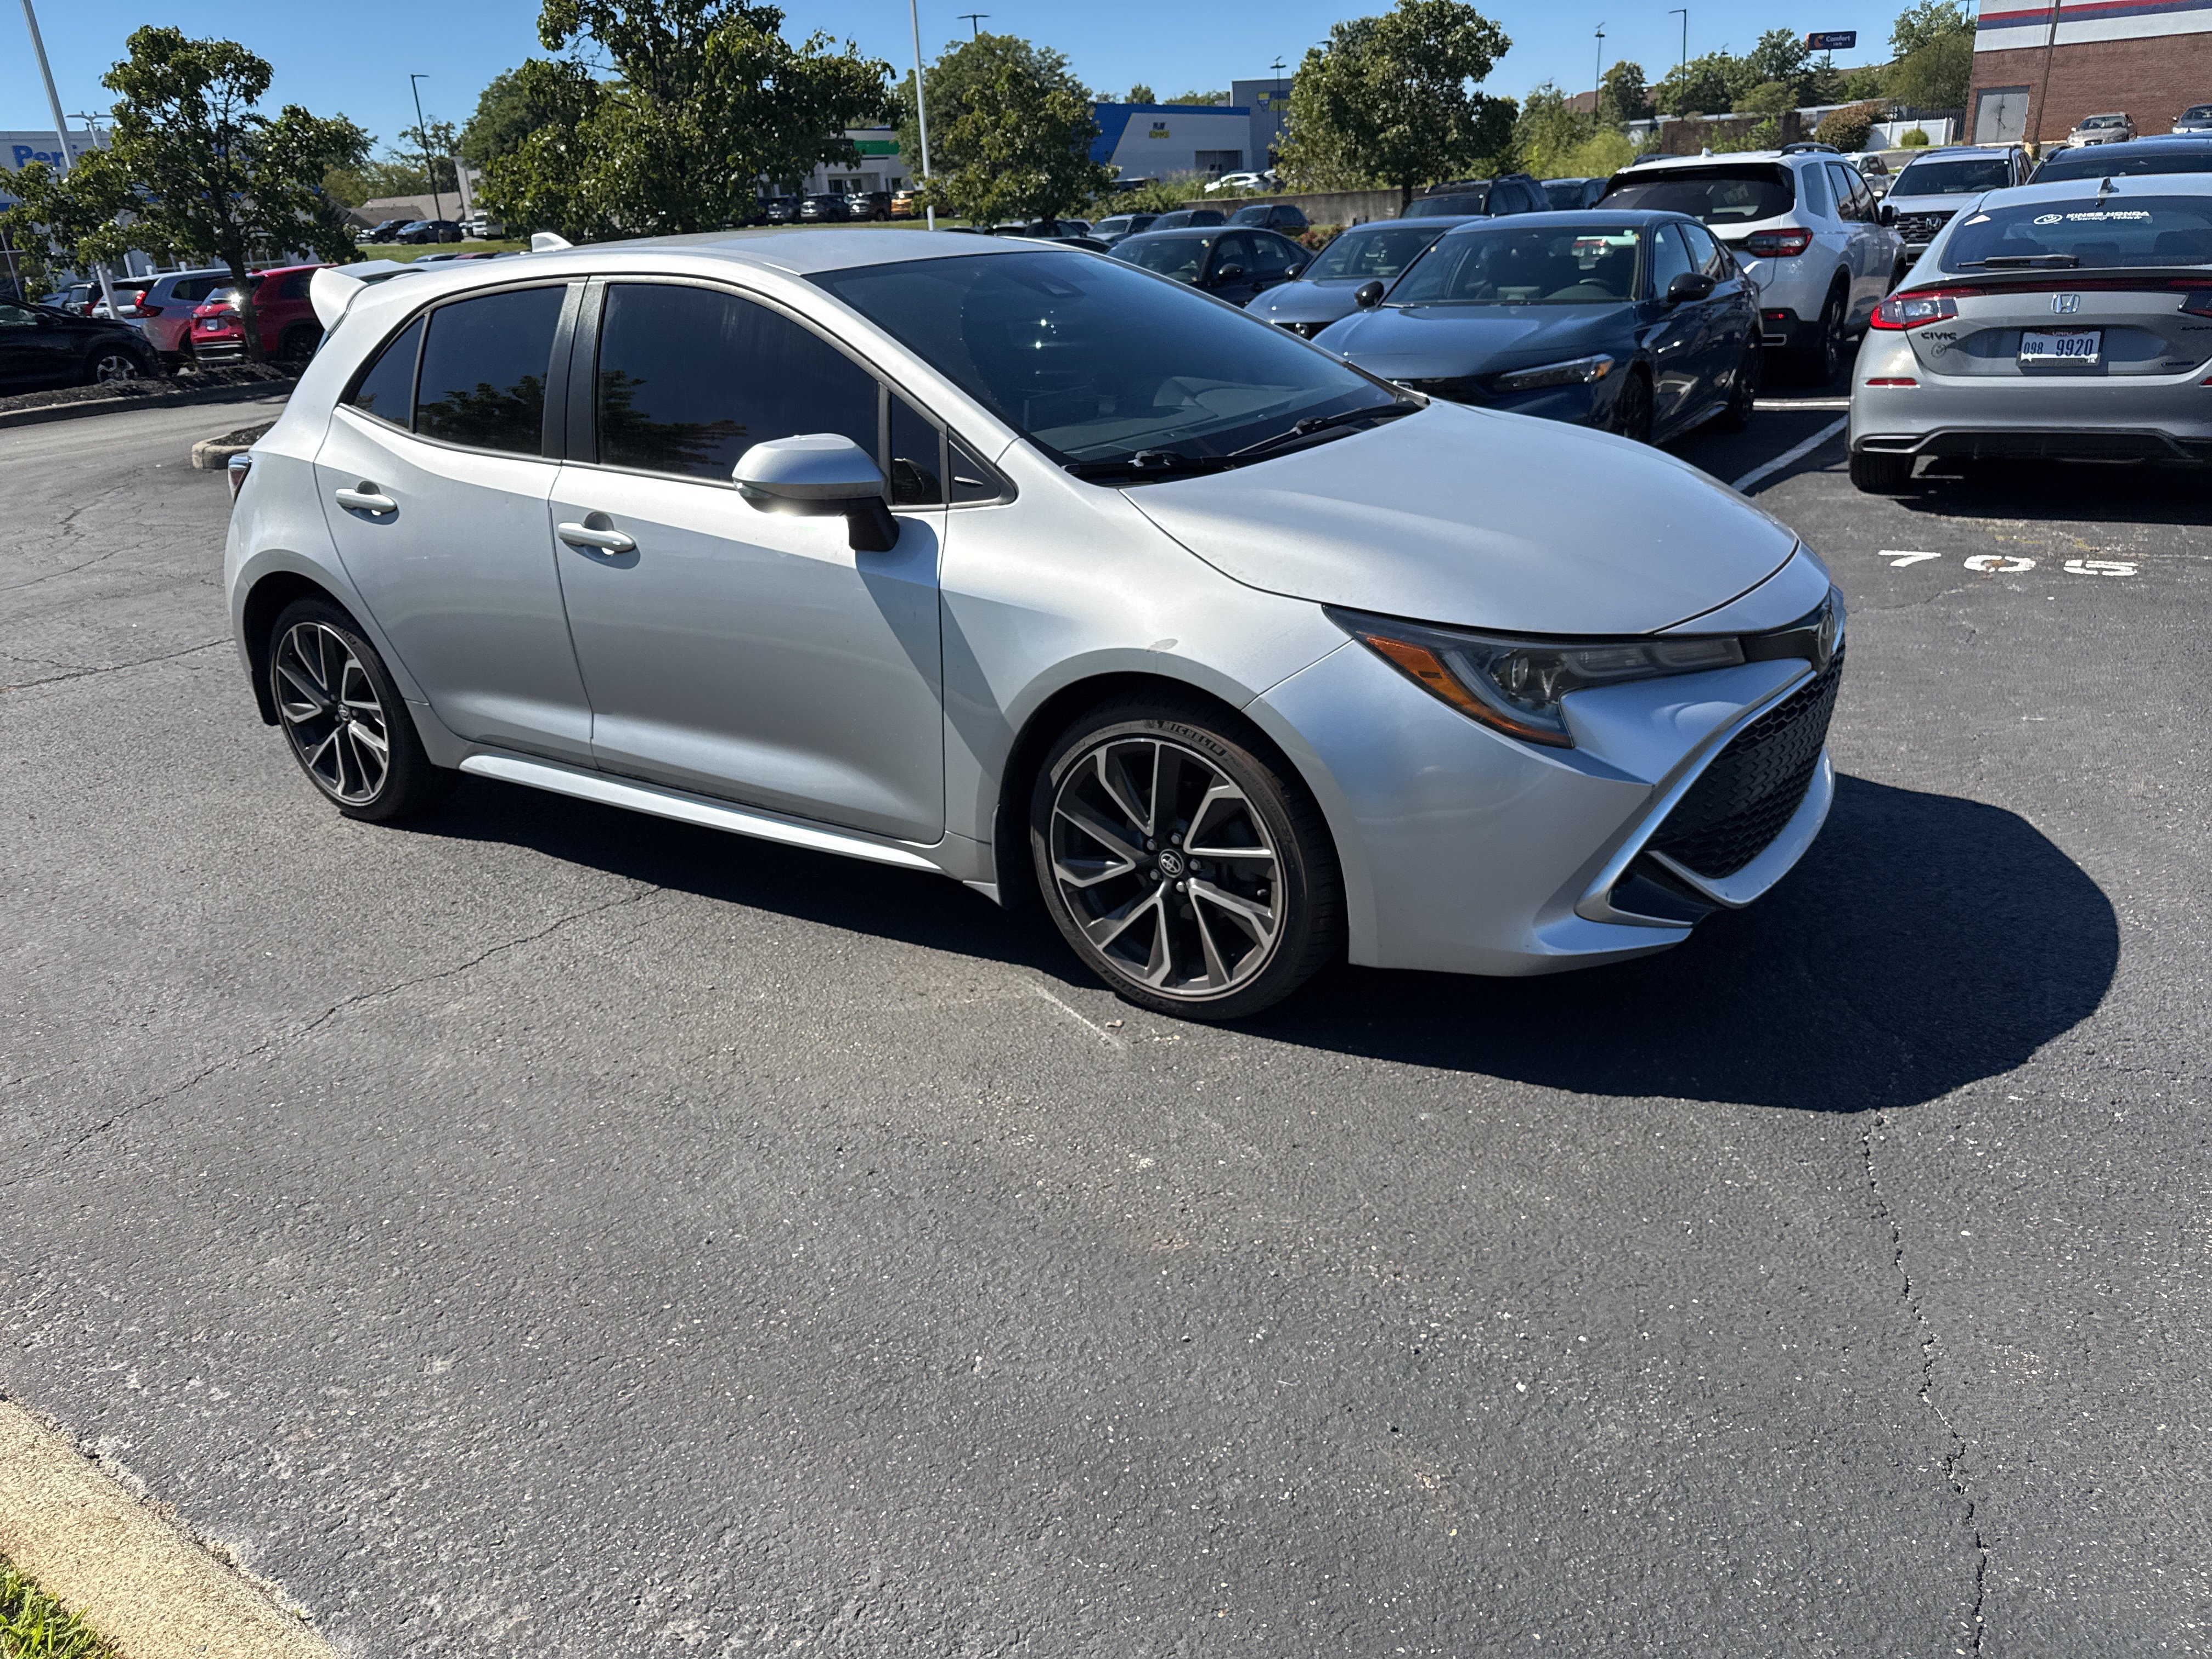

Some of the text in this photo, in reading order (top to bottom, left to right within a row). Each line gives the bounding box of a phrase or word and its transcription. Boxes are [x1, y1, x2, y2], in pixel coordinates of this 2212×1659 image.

[1921, 331, 1957, 340] CIVIC
[2023, 338, 2094, 356] 098 9920
[1161, 720, 1226, 755] MICHELIN
